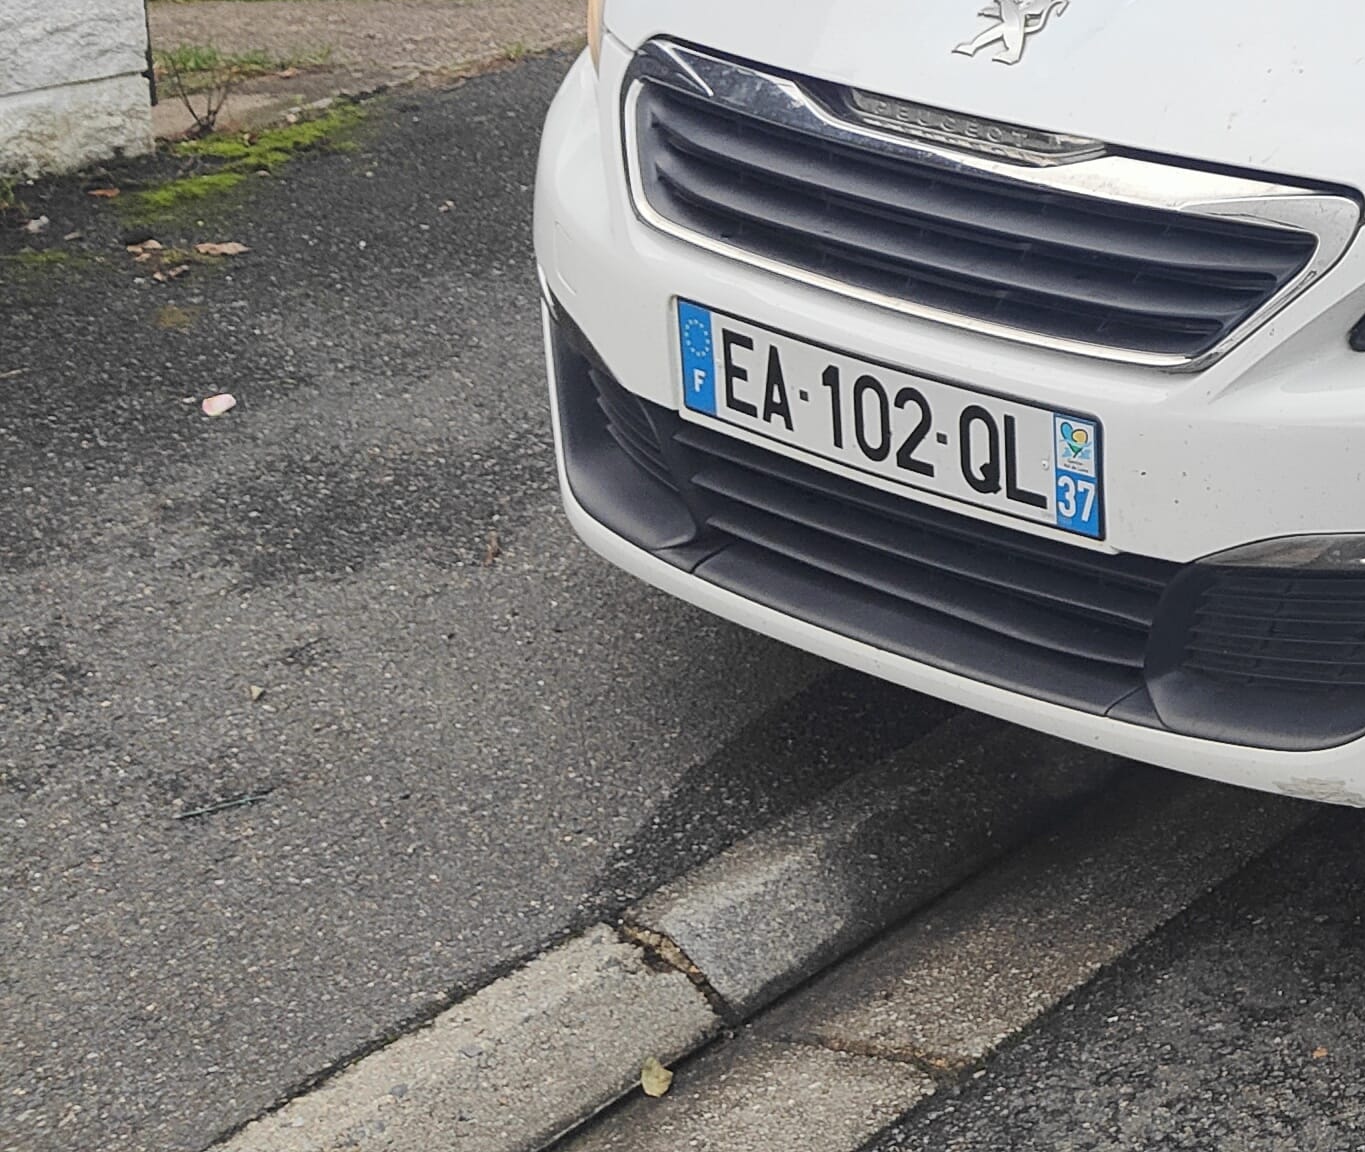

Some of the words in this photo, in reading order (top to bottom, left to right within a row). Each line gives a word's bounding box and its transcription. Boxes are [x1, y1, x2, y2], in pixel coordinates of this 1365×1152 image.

[873, 100, 1029, 147] PEUGEOT
[693, 368, 706, 393] F
[721, 327, 1049, 510] EA-102-QL
[1057, 475, 1096, 523] 37
